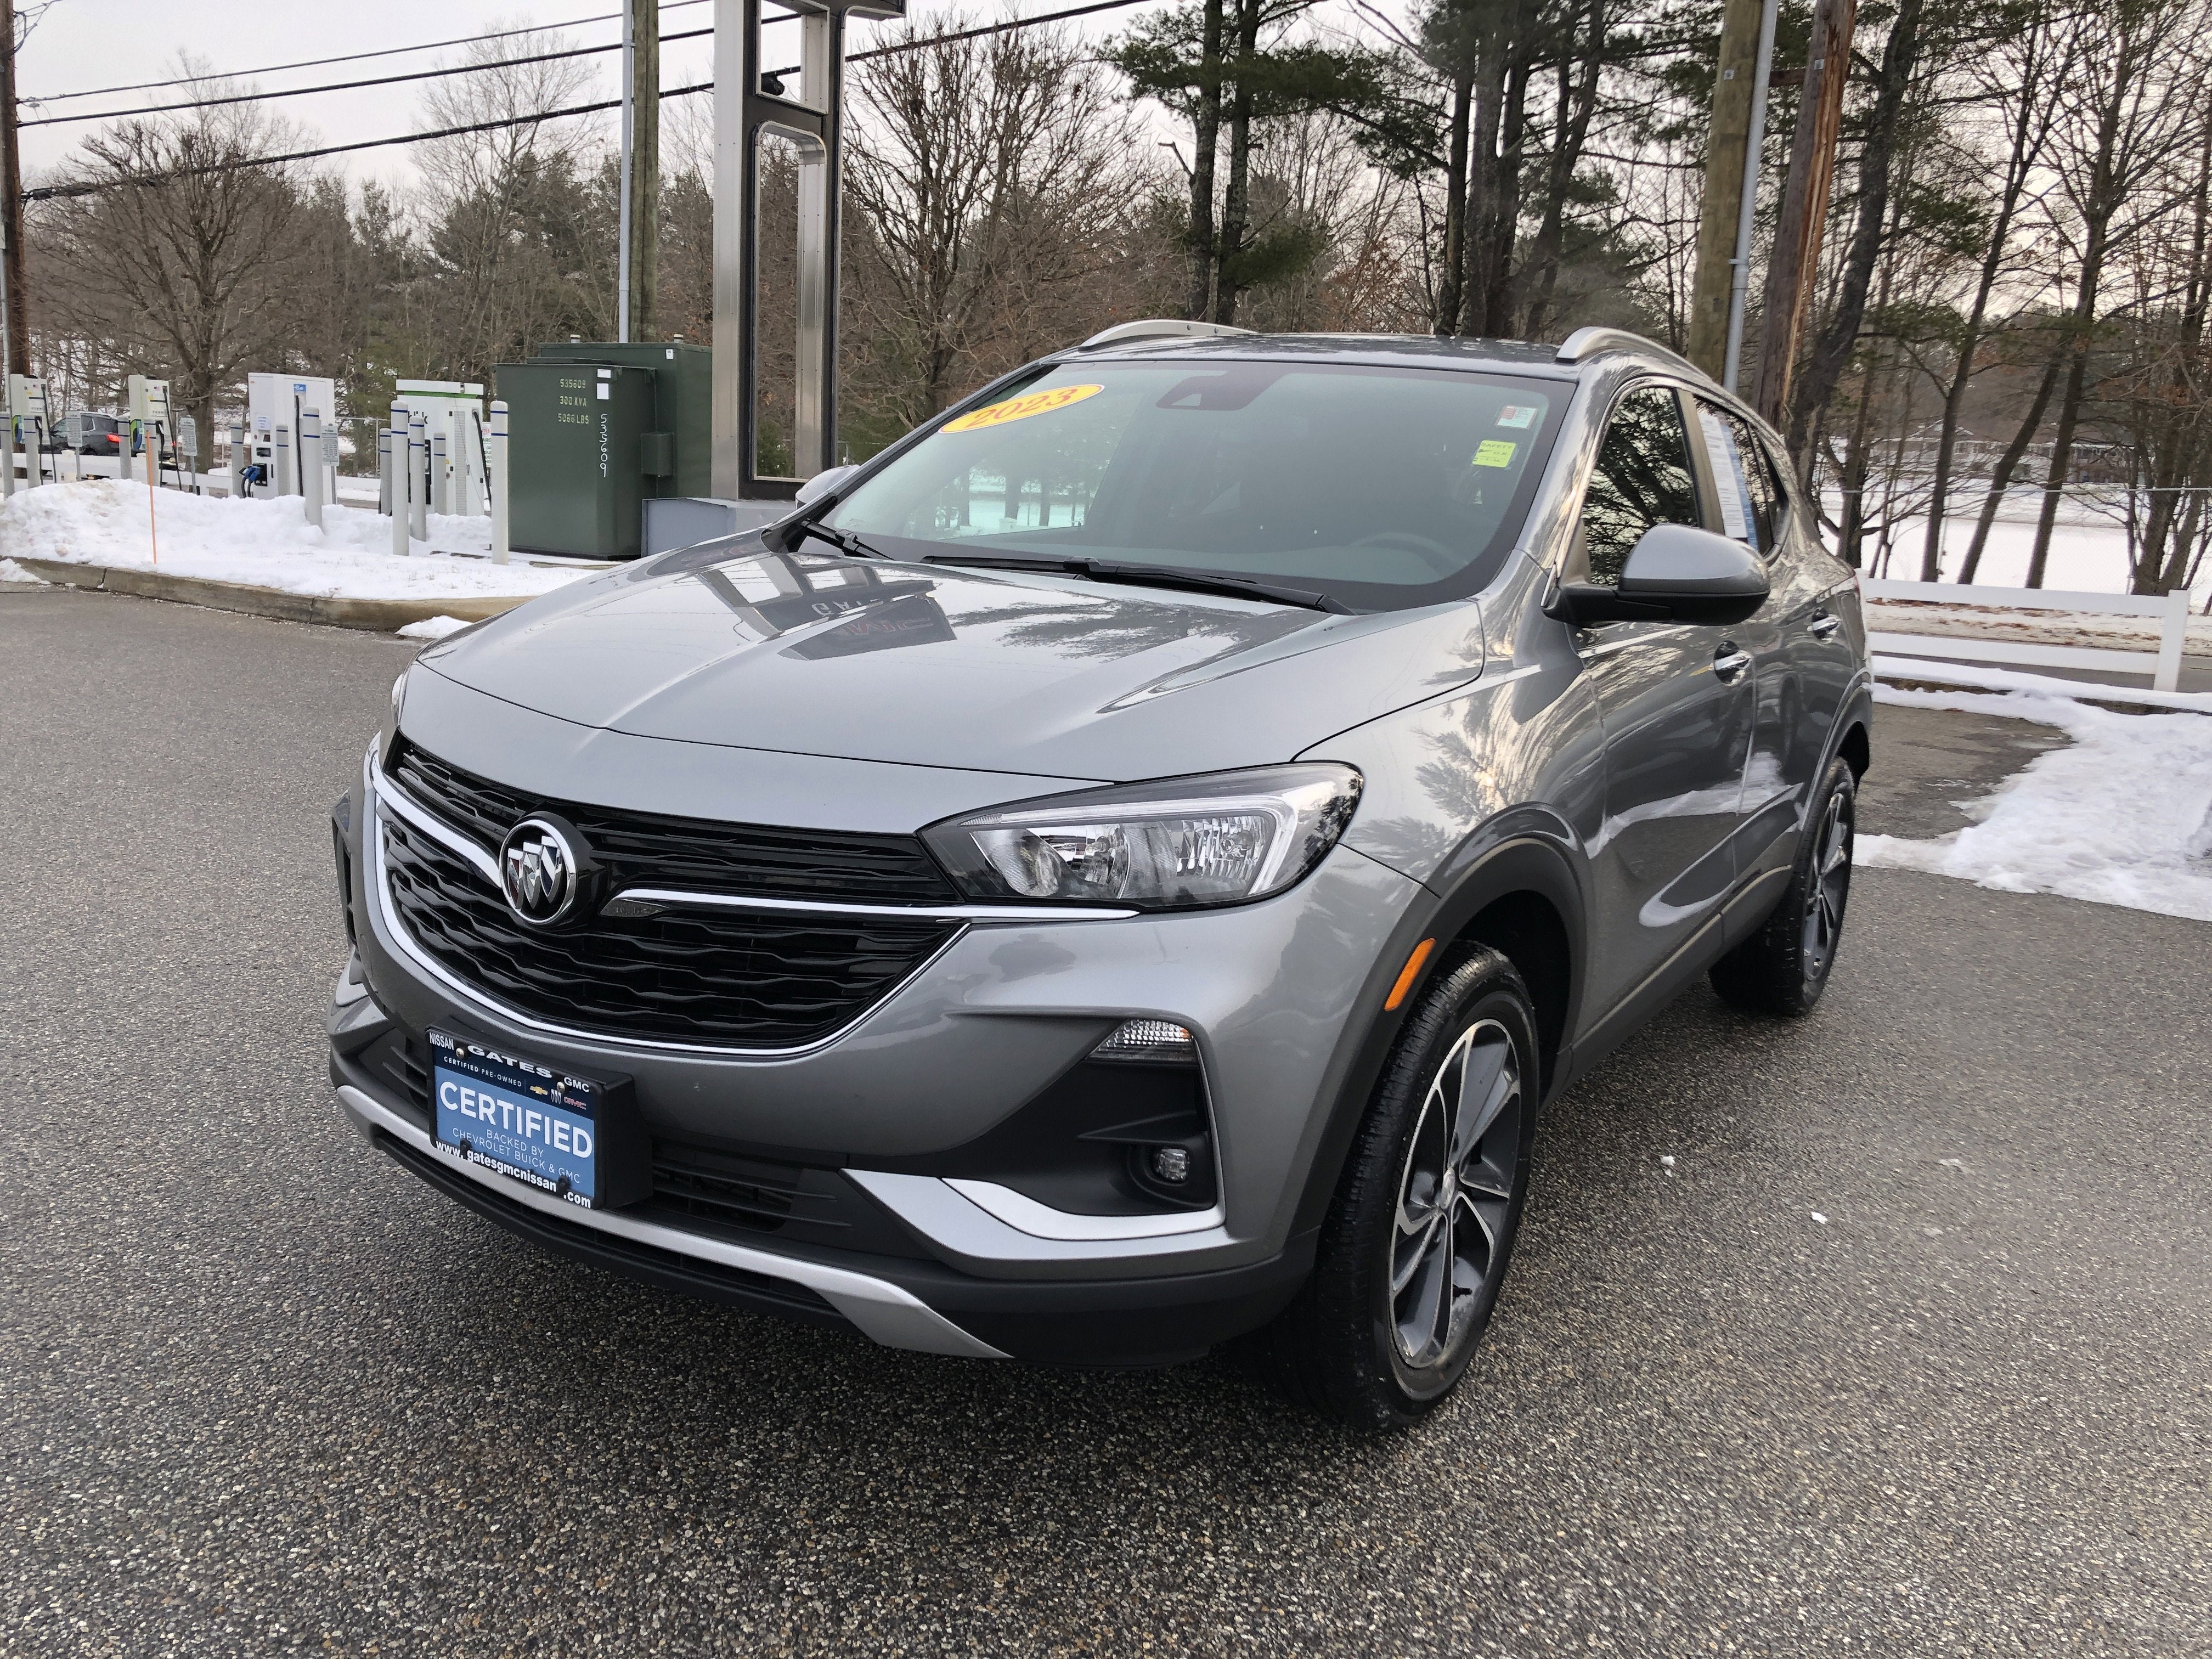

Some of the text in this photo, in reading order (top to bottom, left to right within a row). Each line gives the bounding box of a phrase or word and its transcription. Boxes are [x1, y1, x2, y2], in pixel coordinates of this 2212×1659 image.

[560, 379, 586, 389] 535609
[560, 396, 586, 407] 300 KVA
[576, 415, 589, 424] LBS
[963, 388, 1078, 428] 2023
[599, 413, 608, 478] 535609
[430, 1032, 590, 1093] NISSAN GATES GMC
[443, 1056, 522, 1087] CERTIFIED PRE-OWNED
[439, 1081, 593, 1159] CERTIFIED
[563, 1096, 586, 1110] GMC
[453, 1127, 580, 1183] CHEVROLET BUICK & GMC
[487, 1129, 544, 1158] BACKED BY
[467, 1150, 556, 1192] gatesgmcnissan
